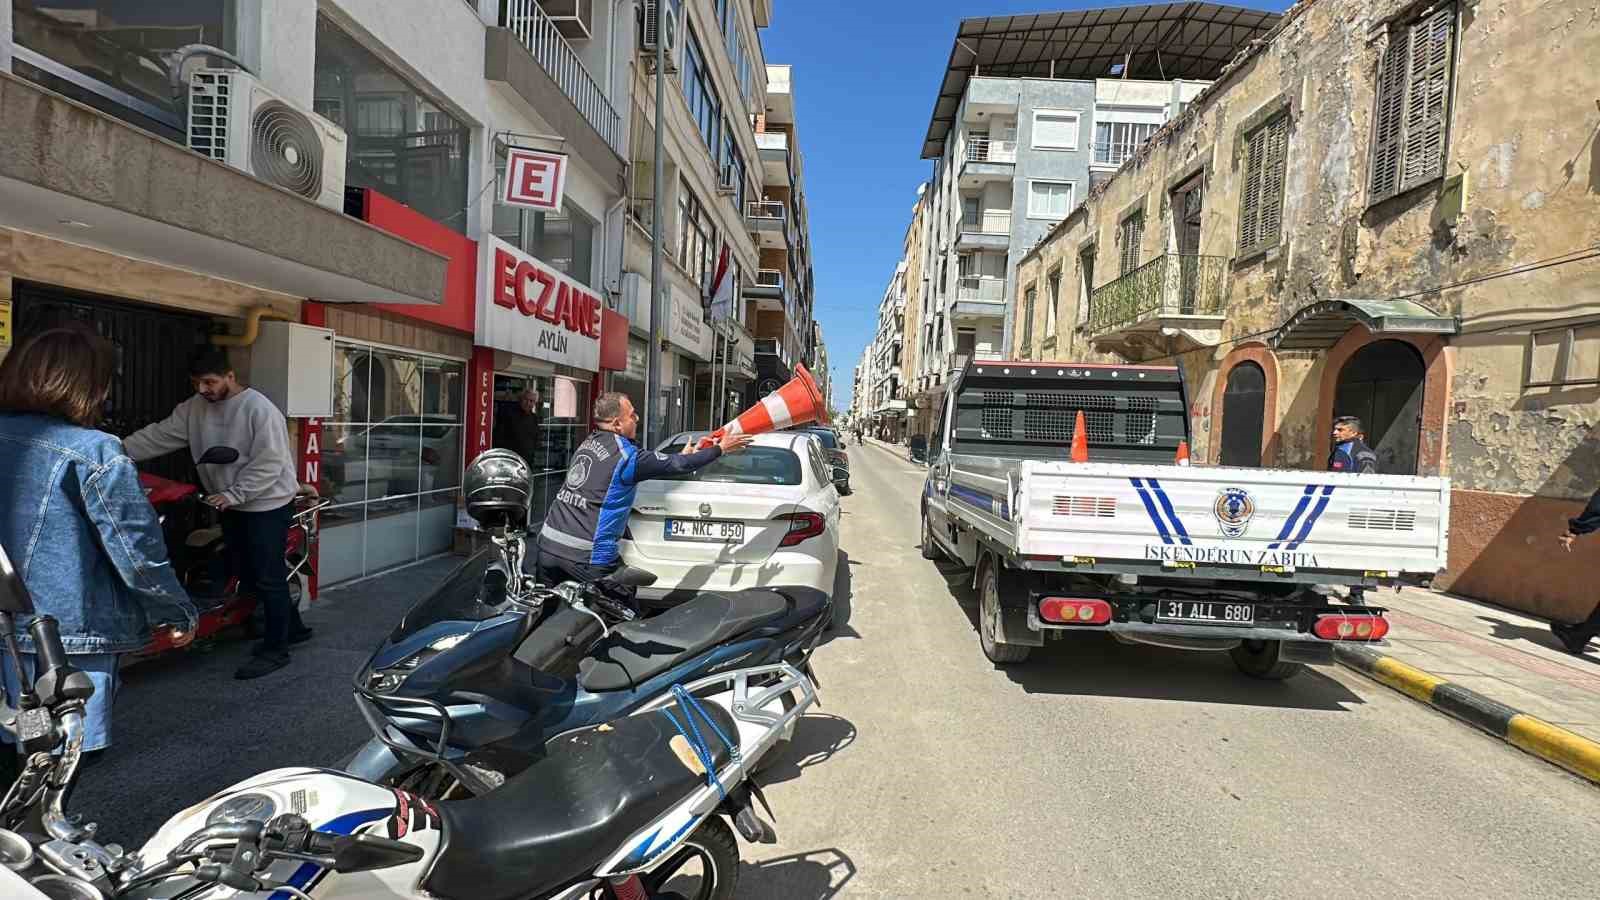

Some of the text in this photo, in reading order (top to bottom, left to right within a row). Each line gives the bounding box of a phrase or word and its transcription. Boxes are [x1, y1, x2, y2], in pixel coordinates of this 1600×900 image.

[520, 162, 547, 198] E
[494, 246, 600, 339] ECZANE
[538, 330, 567, 353] AYLİN
[672, 520, 742, 538] 34 NKC 850
[1144, 543, 1320, 567] İSKENDERUN ZABITA
[1168, 602, 1251, 621] 31 ALL 680
